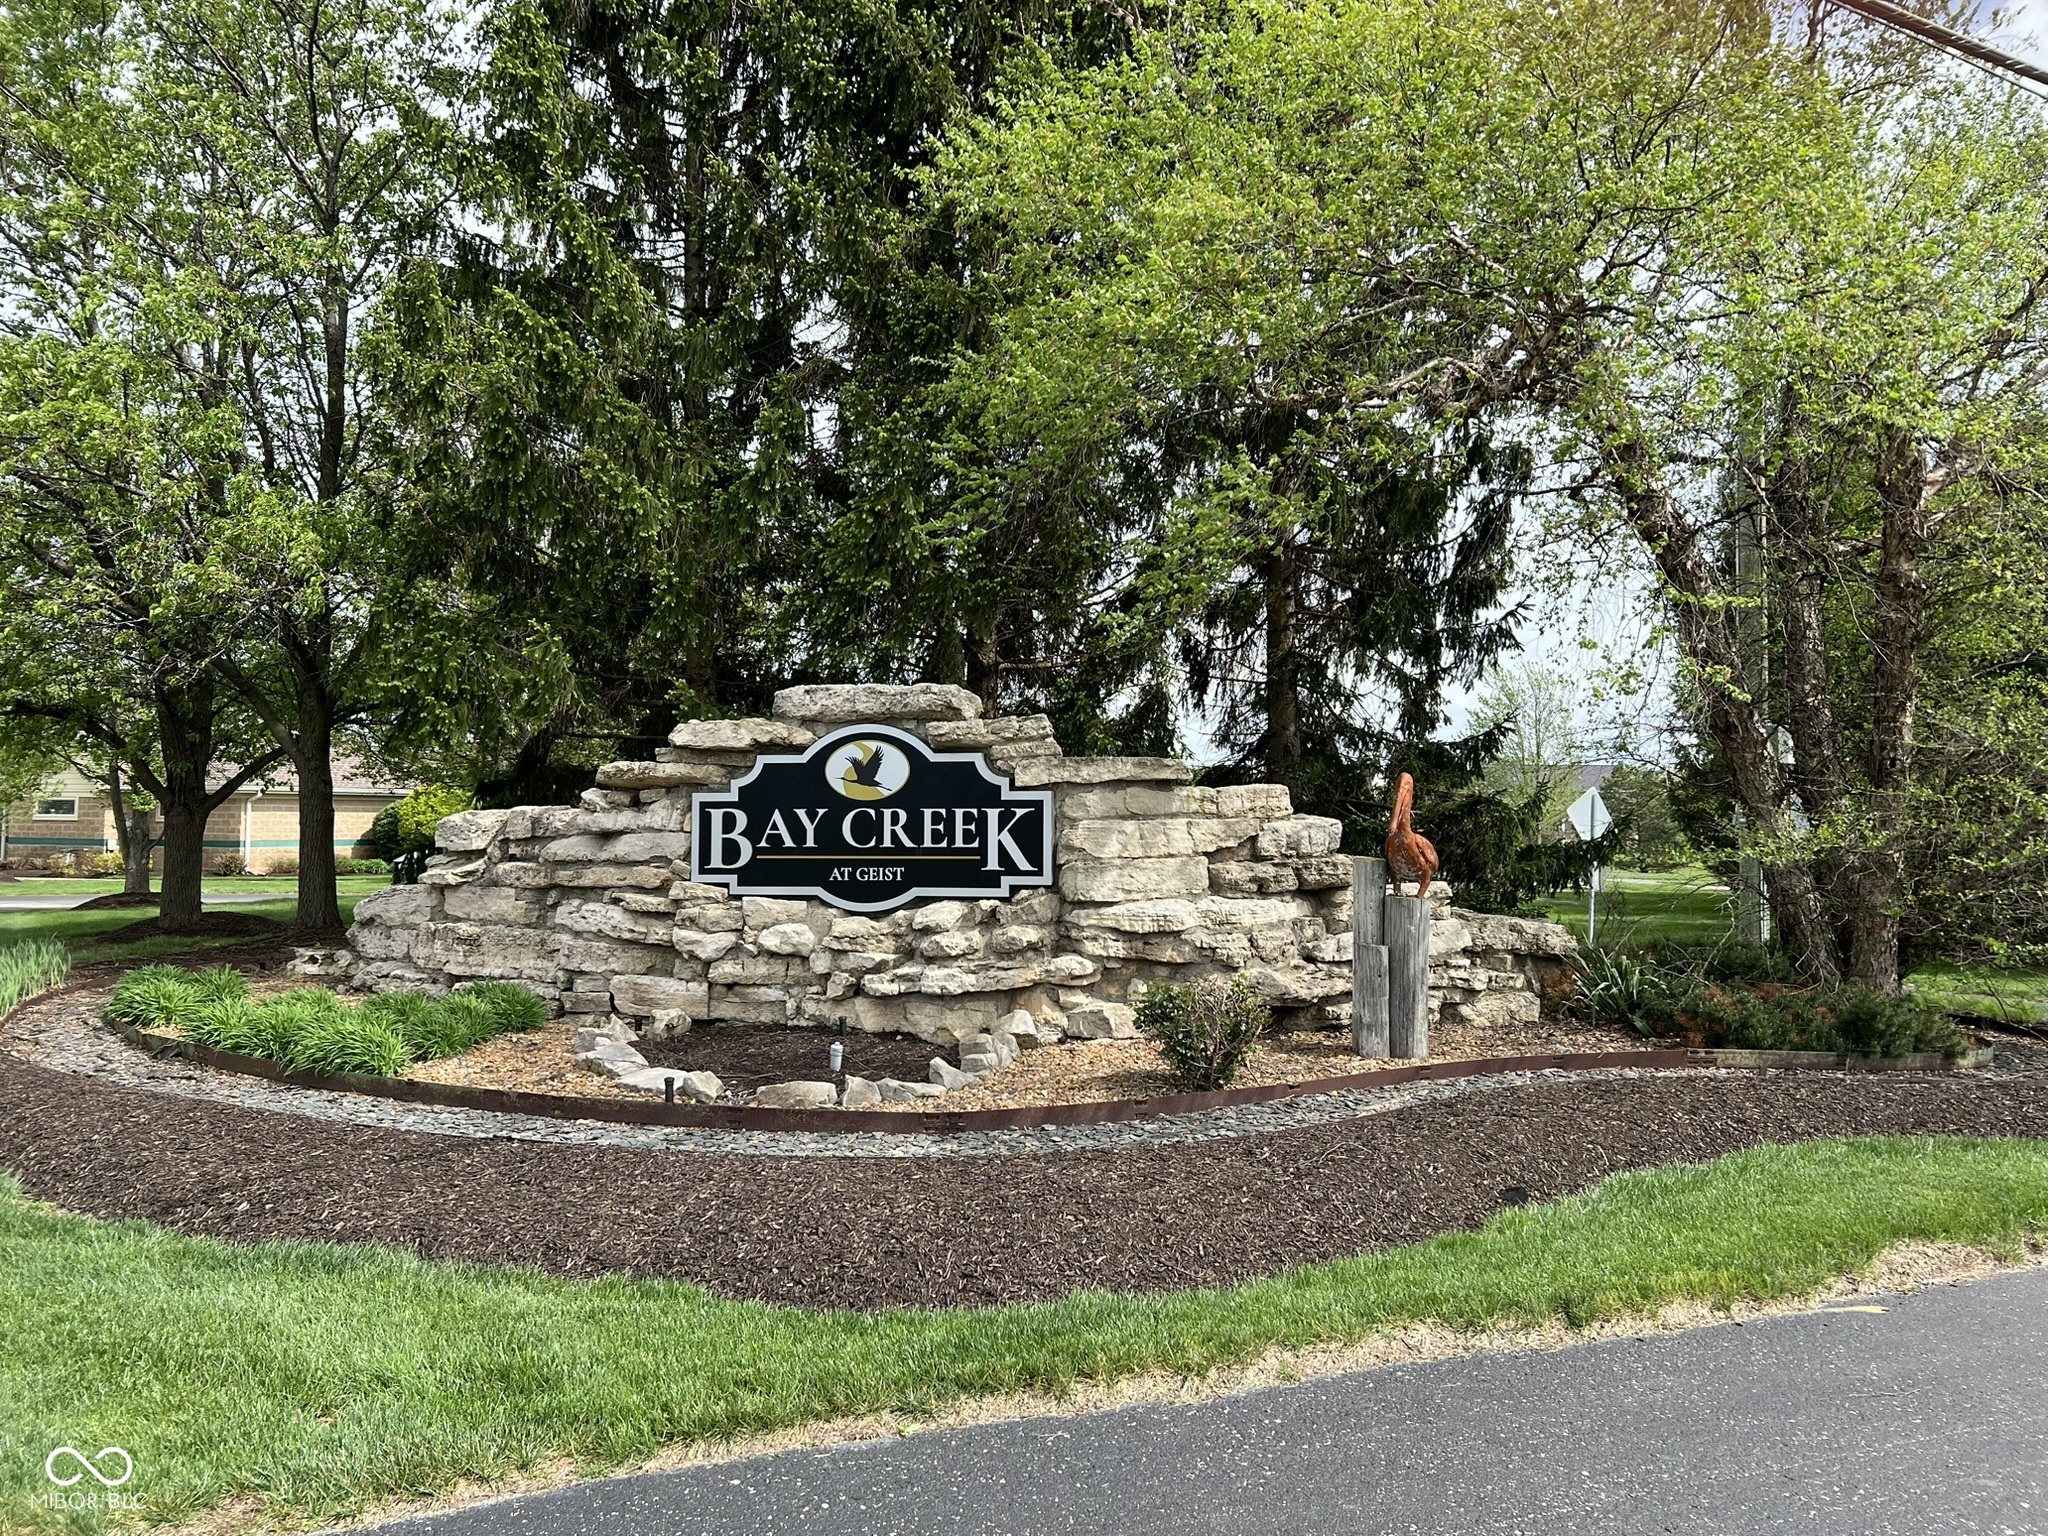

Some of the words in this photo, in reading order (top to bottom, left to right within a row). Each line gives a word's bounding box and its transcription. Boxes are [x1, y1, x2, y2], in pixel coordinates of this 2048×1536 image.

[704, 808, 829, 869] BAY
[841, 808, 1038, 871] CREEK
[829, 867, 852, 881] AT
[856, 867, 905, 881] GEIST
